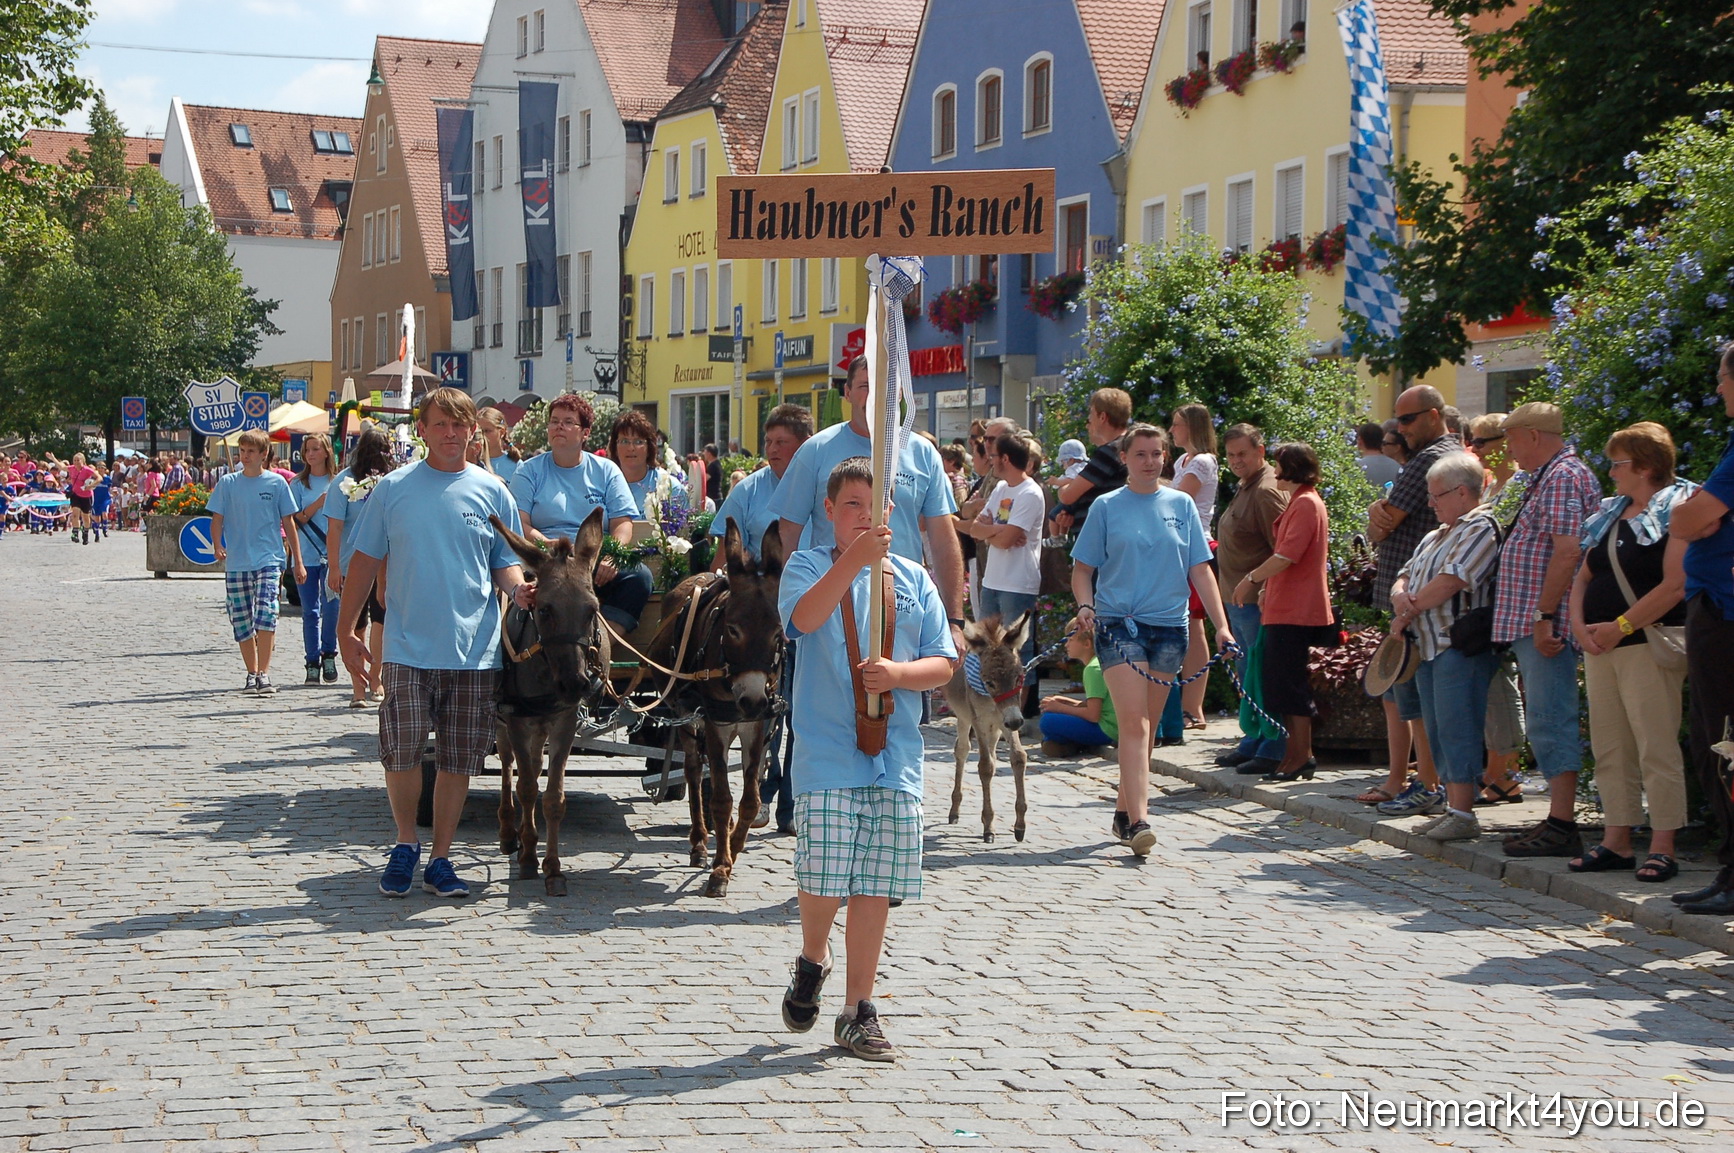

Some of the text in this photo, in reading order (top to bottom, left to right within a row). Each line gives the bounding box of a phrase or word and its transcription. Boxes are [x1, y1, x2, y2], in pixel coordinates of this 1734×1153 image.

[523, 158, 550, 225] K&L
[727, 182, 1044, 242] Haubner's Ranch
[678, 230, 706, 259] HOTEL
[711, 351, 746, 360] TAIFN
[783, 339, 807, 357] AIFUN
[674, 364, 713, 383] Restaurant
[204, 389, 222, 403] SV
[198, 403, 237, 421] STAUF
[125, 419, 144, 428] TAXI
[210, 419, 231, 430] 1980
